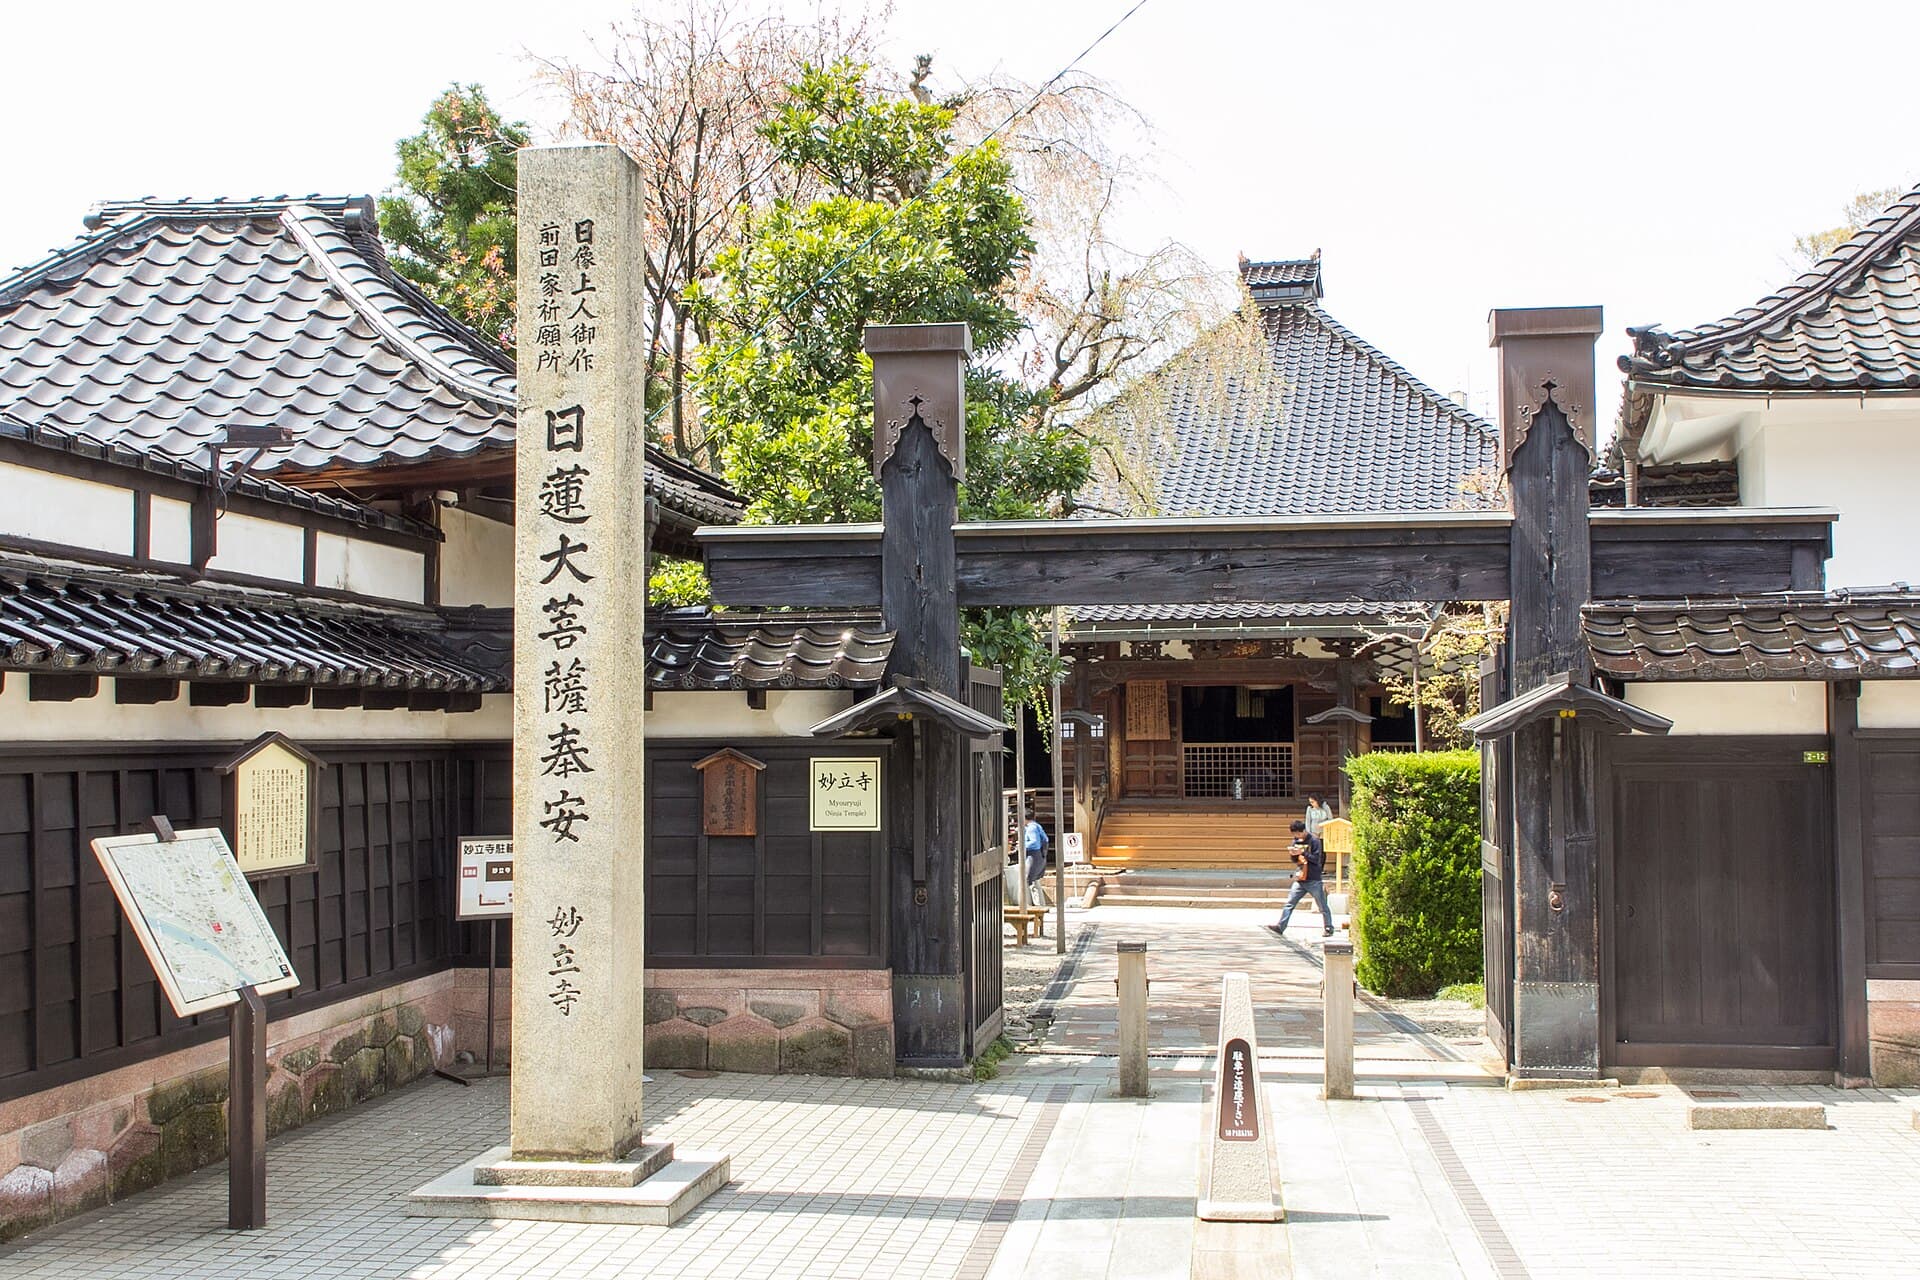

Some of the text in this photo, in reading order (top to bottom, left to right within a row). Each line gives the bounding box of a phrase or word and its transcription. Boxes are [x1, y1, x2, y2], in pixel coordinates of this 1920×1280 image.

[535, 221, 563, 373] 前田家祈願所
[567, 218, 598, 372] 日像上人御作
[538, 404, 595, 844] 日蓮大菩薩奉安
[818, 771, 873, 791] 妙立寺
[828, 799, 862, 807] Myouryuji
[546, 906, 584, 1016] 妙立寺
